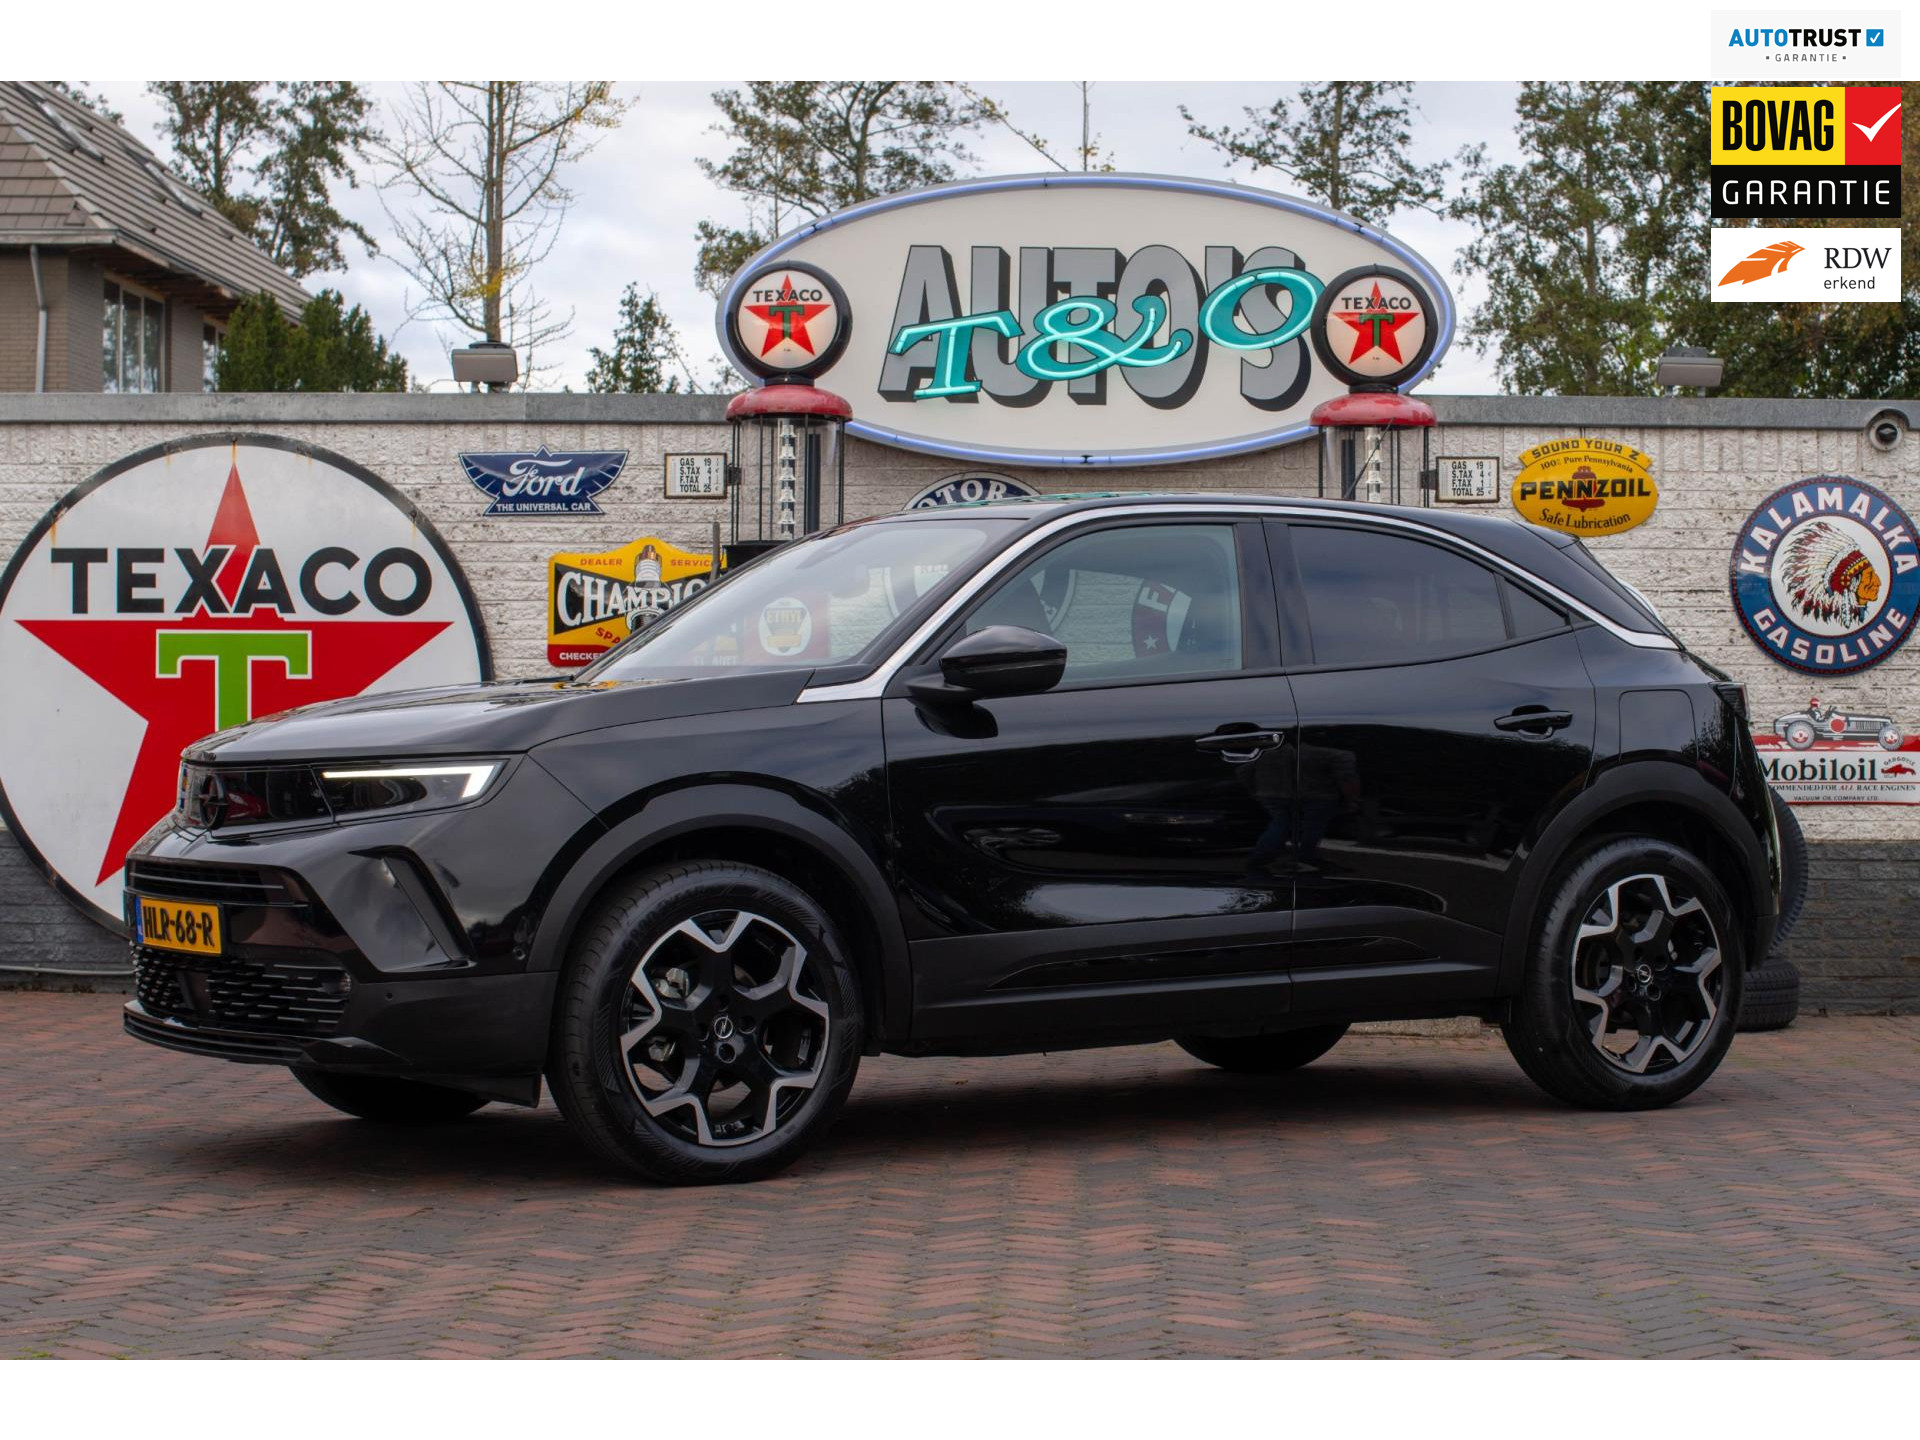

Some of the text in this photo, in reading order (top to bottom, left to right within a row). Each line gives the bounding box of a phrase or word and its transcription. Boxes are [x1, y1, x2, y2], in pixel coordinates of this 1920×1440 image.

[753, 289, 823, 302] TEXACO
[1341, 296, 1412, 310] TEXACO
[878, 245, 1311, 411] AUTO'S
[1532, 440, 1640, 461] SOUND YOUR Z
[680, 457, 712, 466] GAS 19
[1451, 461, 1484, 470] GAS 19
[1564, 456, 1582, 464] Pure
[1584, 455, 1633, 473] Pennsylvania
[502, 459, 586, 497] Ford
[680, 467, 700, 475] S.TAX
[1452, 470, 1473, 479] S.TAX
[680, 476, 699, 484] F.TAX
[1452, 479, 1472, 487] F.TAX
[680, 485, 712, 493] TOTAL 25
[1452, 487, 1485, 496] TOTAL 25
[1520, 478, 1652, 501] PENNZOIL
[496, 502, 591, 512] THE UNIVERSAL CAR
[1539, 508, 1632, 530] Safe Lubrication
[1740, 487, 1919, 575] KALAMALKA
[580, 558, 623, 566] DEALER
[51, 546, 433, 617] TEXACO
[595, 627, 622, 644] SPA
[1753, 608, 1908, 664] GASOLINE
[559, 652, 604, 661] CHECKE
[1759, 758, 1878, 781] Mobiloil
[142, 906, 216, 948] HLR-68-R
